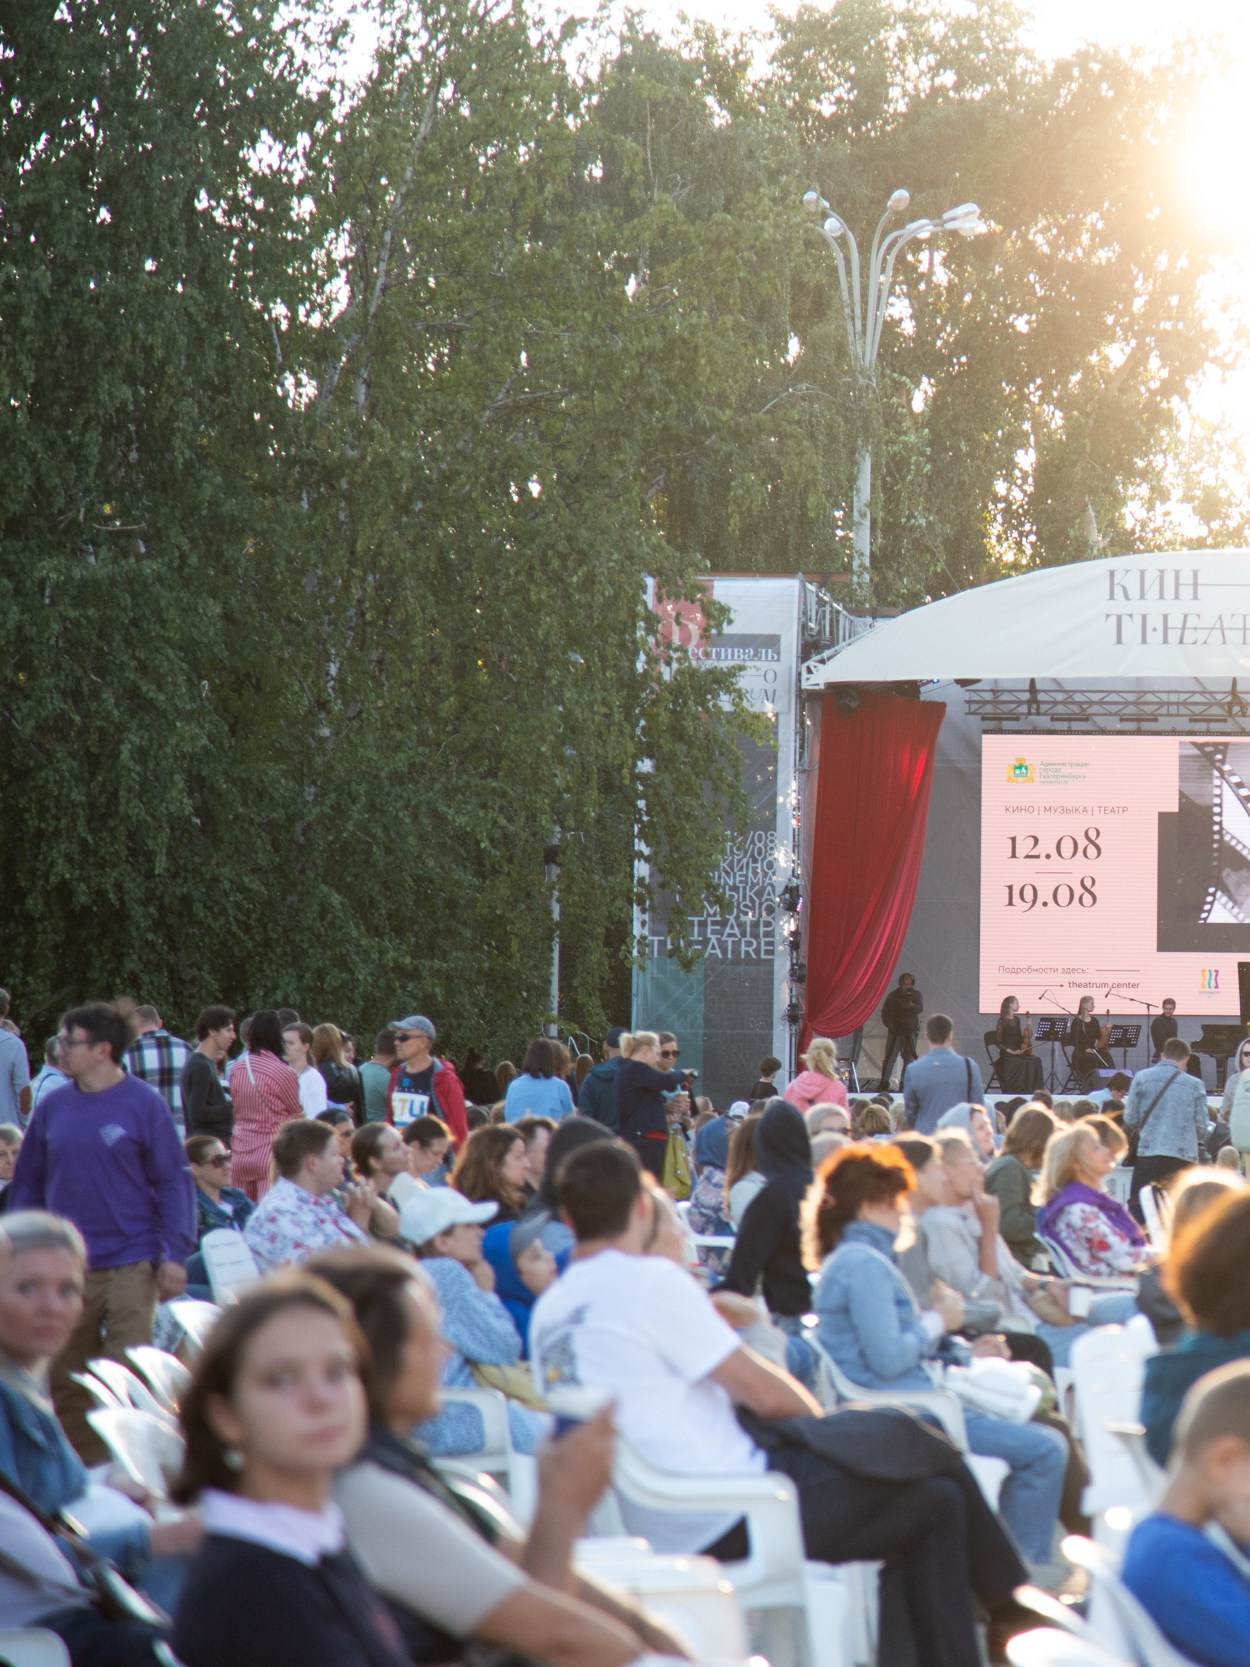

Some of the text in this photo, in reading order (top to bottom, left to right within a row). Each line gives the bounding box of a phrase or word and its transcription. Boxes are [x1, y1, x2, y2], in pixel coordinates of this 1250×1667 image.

[687, 645, 778, 662] естиваль
[1004, 805, 1129, 815] КИНО МУЗЫКА ТЕАТР
[1006, 826, 1102, 860] 12.08
[720, 857, 777, 873] КИНО
[710, 871, 777, 886] INEMA
[1003, 875, 1098, 913] 19.08
[687, 916, 775, 940] ТЕАТР
[998, 966, 1090, 975] Подробности здесь:
[1068, 980, 1141, 989] theatrum.center
